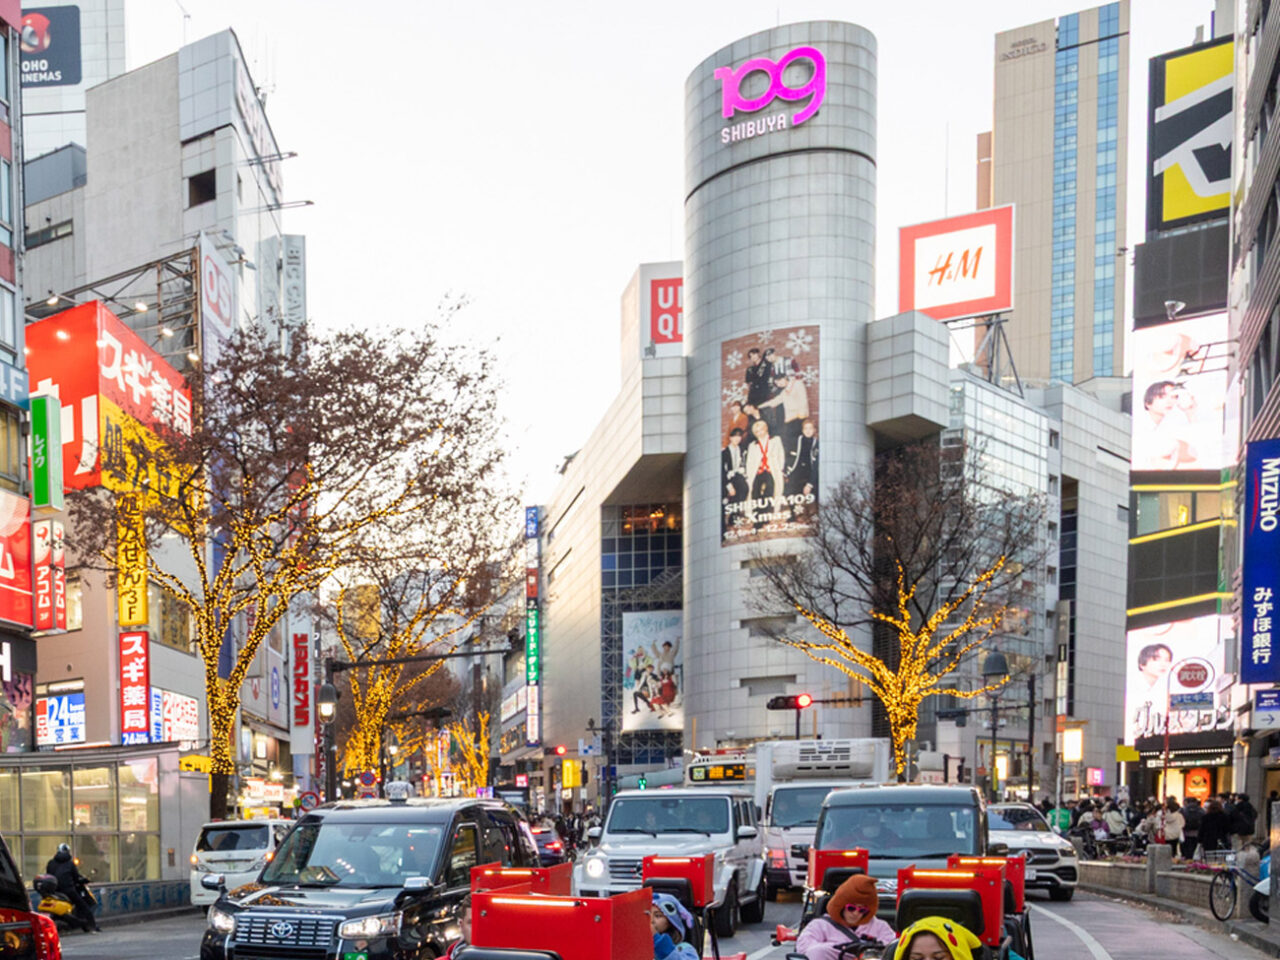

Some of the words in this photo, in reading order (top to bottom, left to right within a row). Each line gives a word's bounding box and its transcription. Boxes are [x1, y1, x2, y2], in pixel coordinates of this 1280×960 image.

[21, 71, 63, 82] INEMAS
[22, 59, 49, 72] OHO
[714, 46, 827, 126] 109
[721, 114, 787, 144] SHIBUYA
[926, 246, 983, 286] H&M
[724, 494, 815, 514] SHIBUYA109
[1260, 458, 1280, 532] MIZUHO
[37, 566, 51, 608] アコム
[1252, 587, 1274, 665] みずほ銀行
[122, 635, 147, 730] スギ薬局
[49, 695, 69, 727] 24
